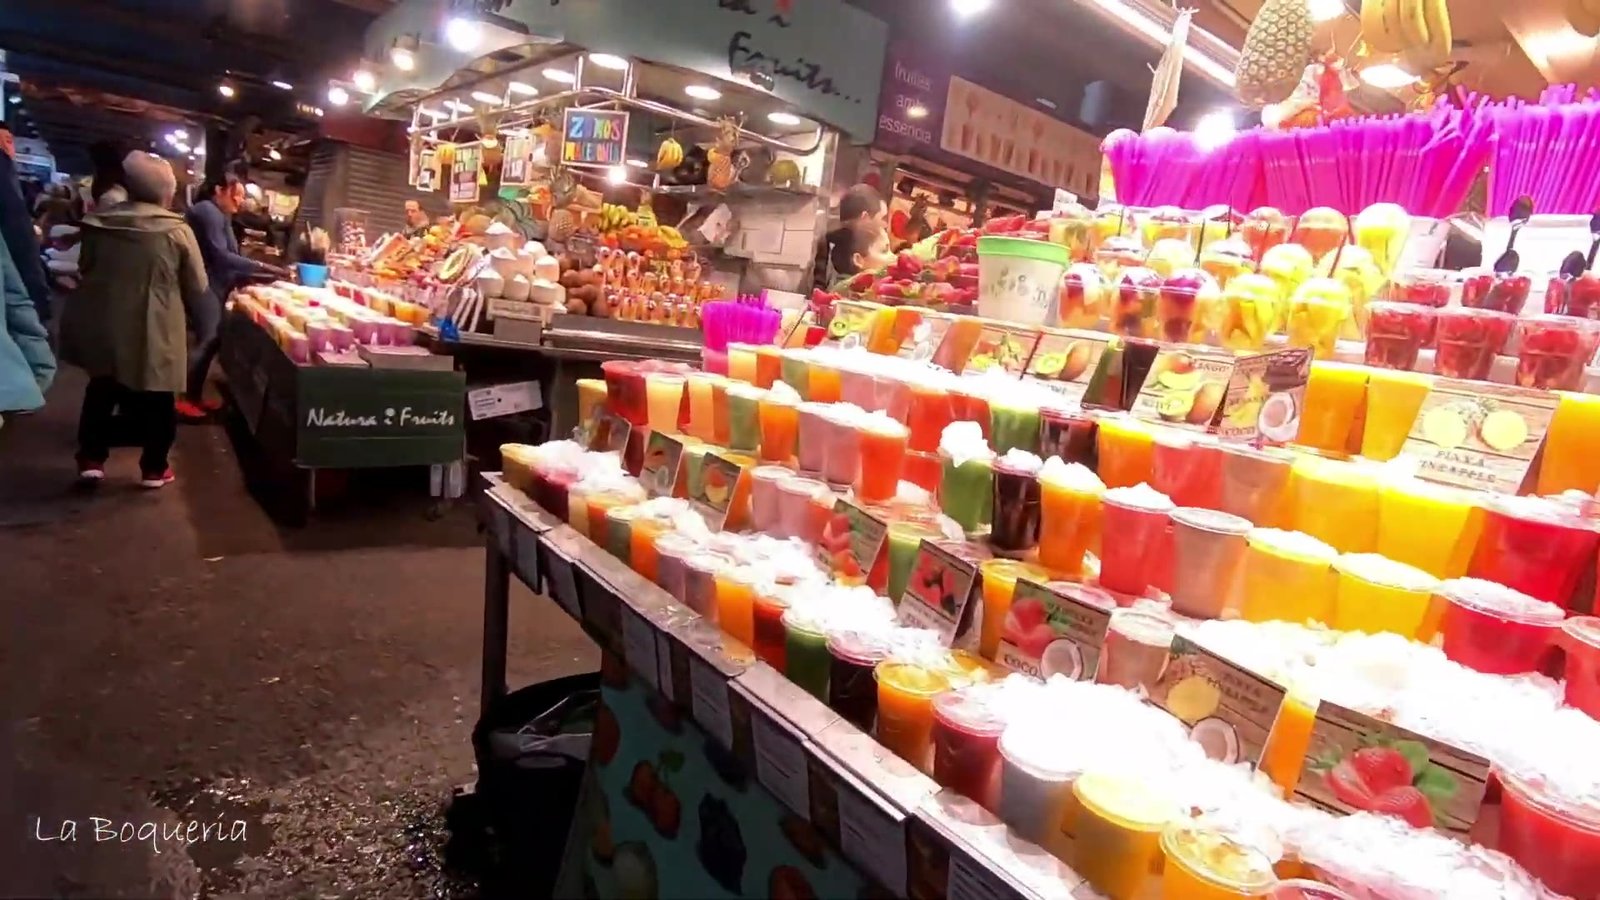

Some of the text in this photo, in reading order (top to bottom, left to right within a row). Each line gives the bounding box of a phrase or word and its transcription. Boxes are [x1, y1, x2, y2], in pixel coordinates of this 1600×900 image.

[306, 407, 455, 427] Natura i Fruits
[1004, 654, 1038, 677] COCO
